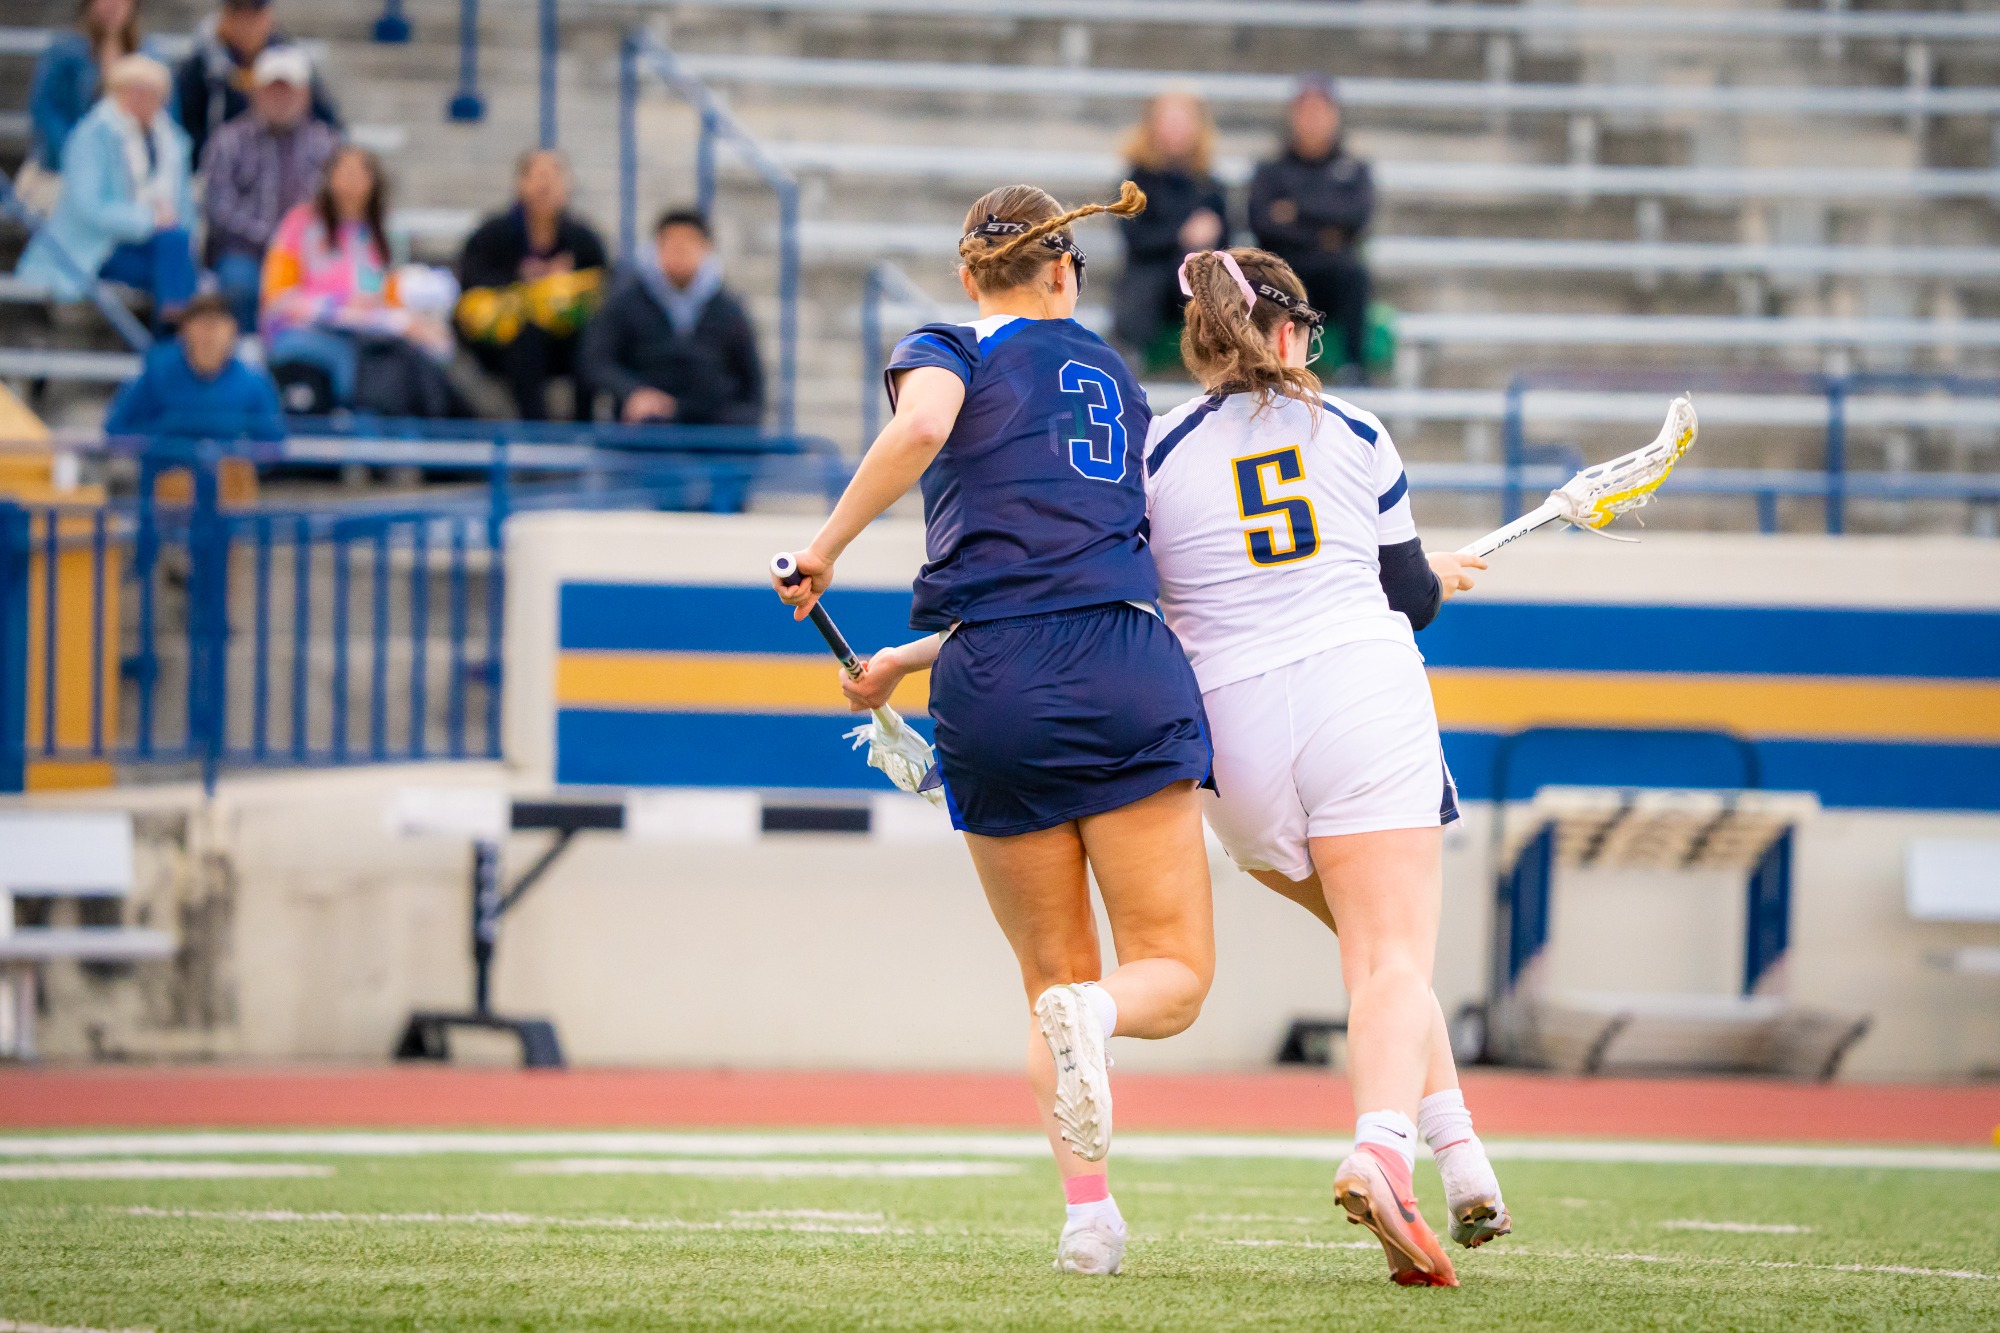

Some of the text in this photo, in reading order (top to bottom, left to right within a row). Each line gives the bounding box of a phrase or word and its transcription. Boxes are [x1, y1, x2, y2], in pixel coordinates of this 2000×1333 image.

[986, 222, 1024, 233] STX
[1259, 284, 1290, 306] STX
[1059, 359, 1128, 483] 3
[1231, 444, 1321, 567] 5
